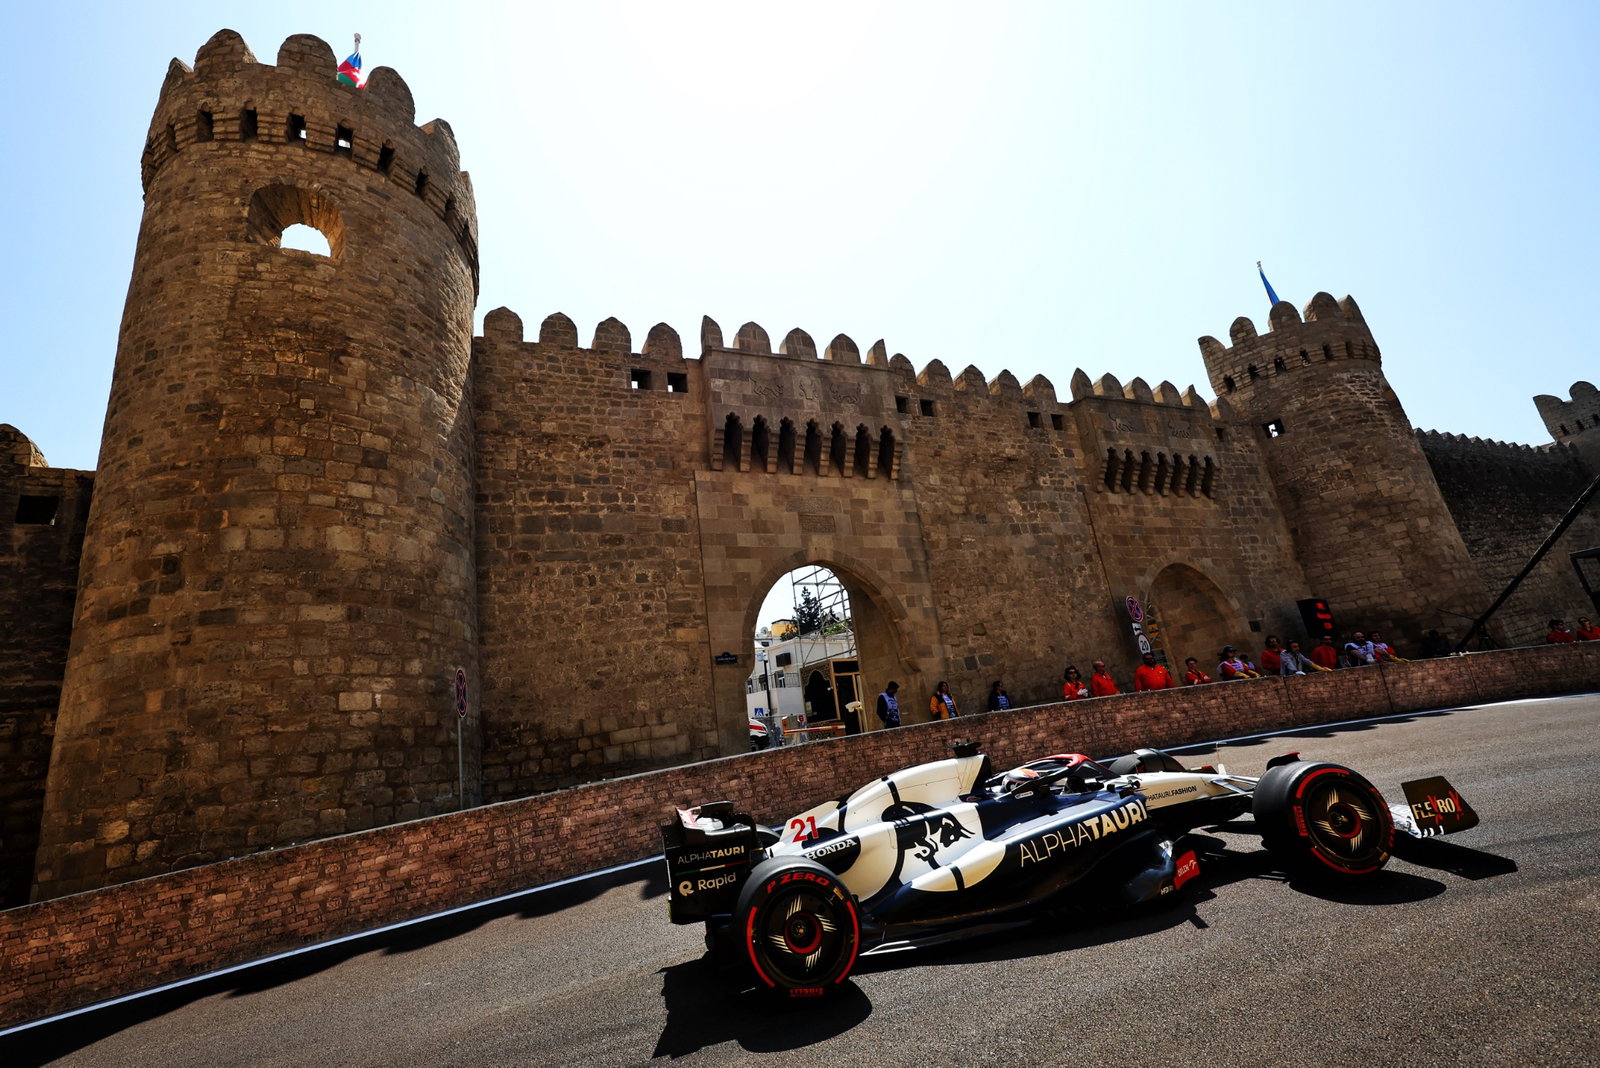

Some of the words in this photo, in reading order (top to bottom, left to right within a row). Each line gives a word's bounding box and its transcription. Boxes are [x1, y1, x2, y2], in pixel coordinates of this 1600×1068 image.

[1140, 641, 1149, 651] 20
[790, 816, 819, 843] 21
[1019, 799, 1148, 868] ALPHATAURI
[678, 845, 745, 865] ALPHATAURI
[805, 839, 857, 860] HONDA
[697, 872, 737, 891] Rapid
[767, 881, 777, 895] P
[780, 872, 831, 887] ZERO
